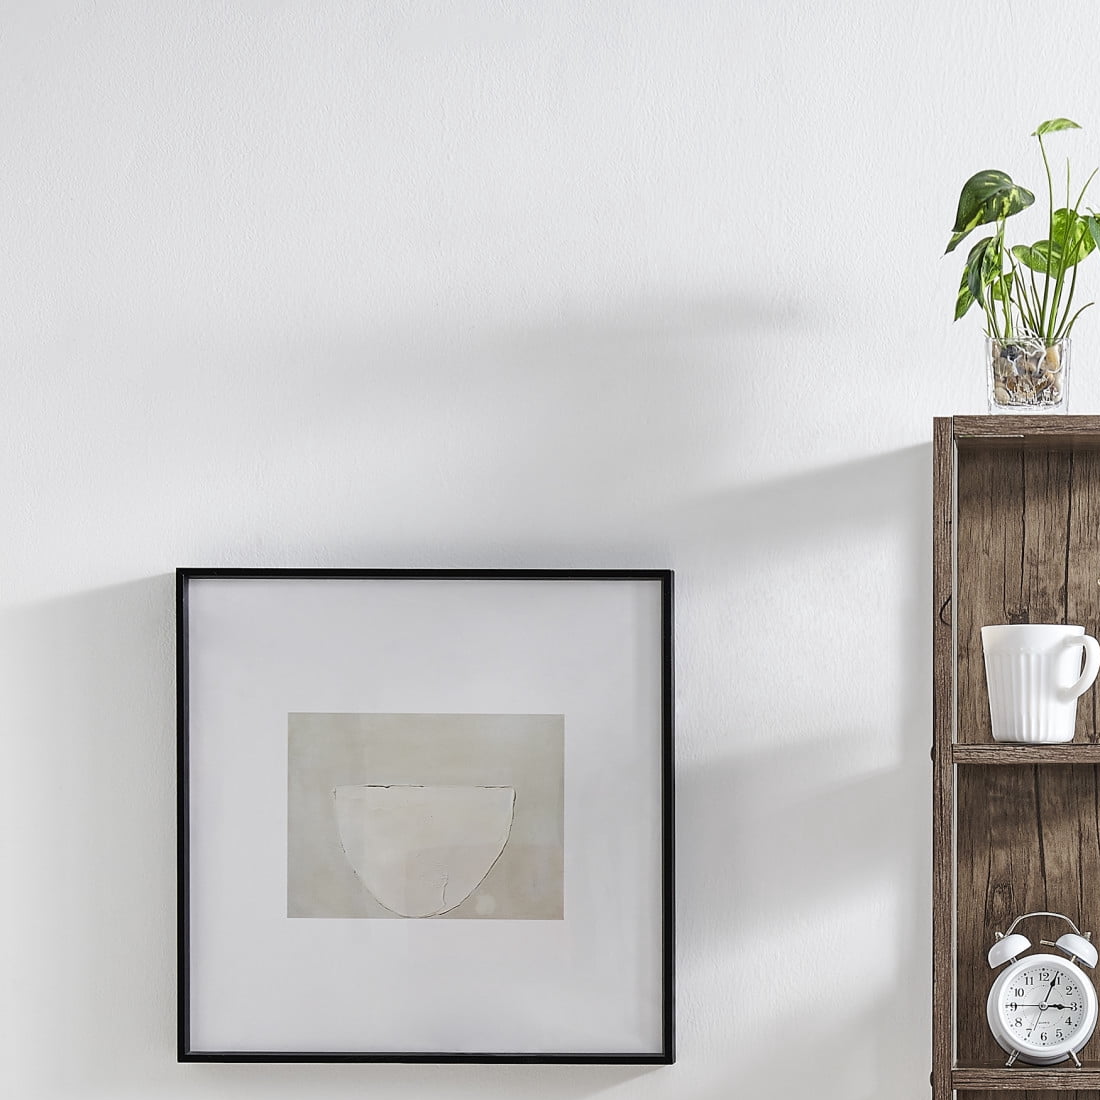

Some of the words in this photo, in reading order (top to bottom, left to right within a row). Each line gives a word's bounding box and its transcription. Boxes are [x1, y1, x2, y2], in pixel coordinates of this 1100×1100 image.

[1025, 976, 1034, 986] 11
[1039, 972, 1050, 982] 12
[1056, 976, 1061, 985] 1
[1014, 988, 1025, 997] 10
[1065, 985, 1073, 996] 2
[1010, 1002, 1018, 1012] 9
[1070, 1002, 1078, 1012] 3
[1014, 1017, 1023, 1028] 8
[1065, 1016, 1073, 1026] 4
[1025, 1028, 1033, 1038] 7
[1040, 1031, 1048, 1041] 6
[1055, 1028, 1063, 1039] 5
